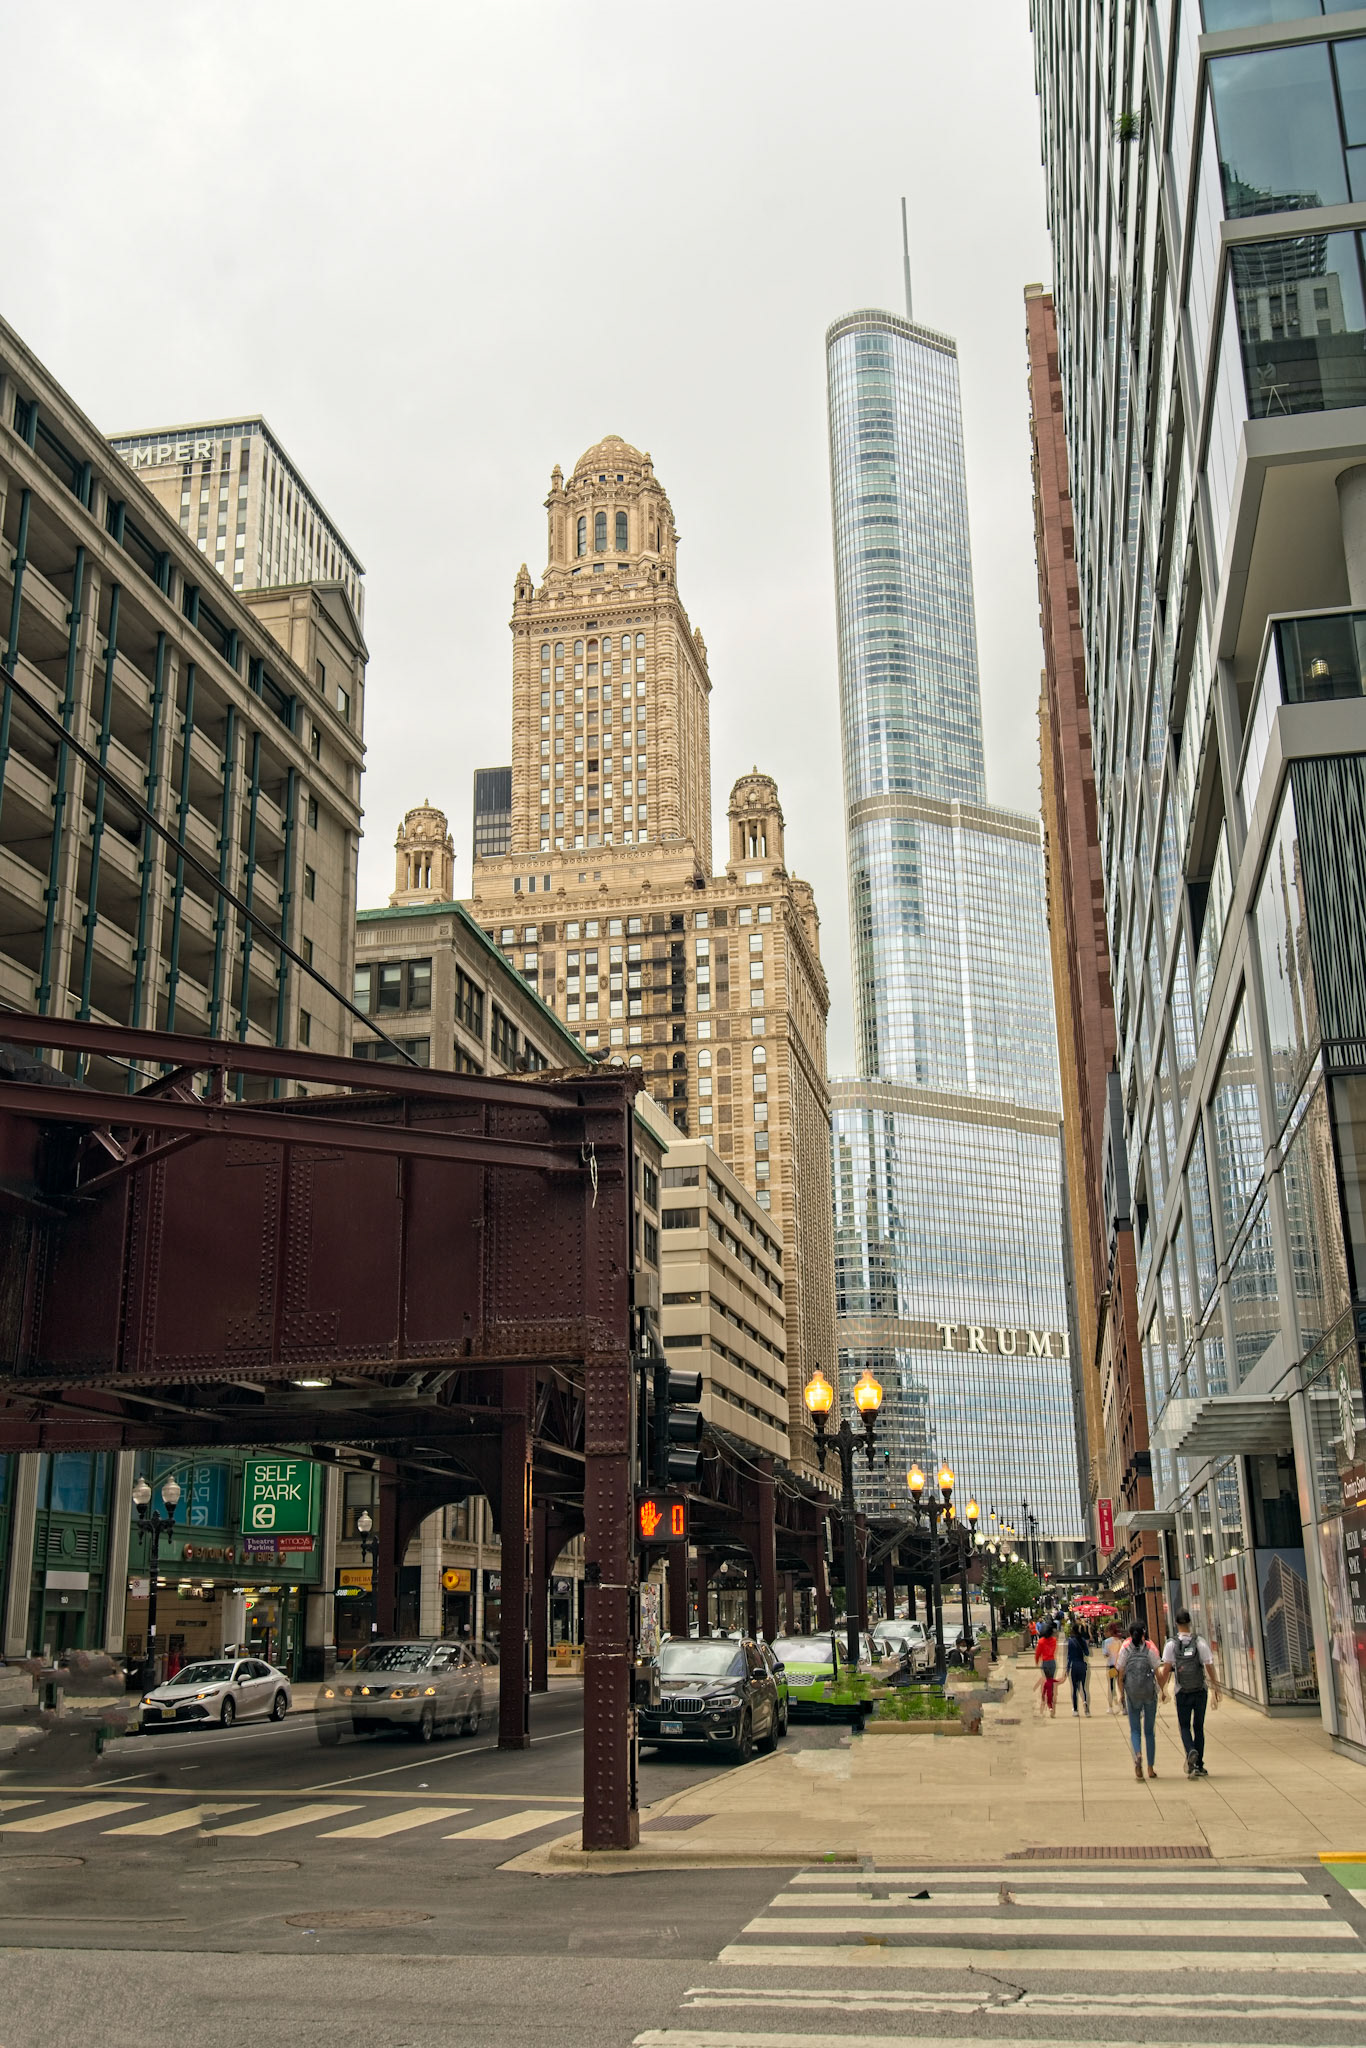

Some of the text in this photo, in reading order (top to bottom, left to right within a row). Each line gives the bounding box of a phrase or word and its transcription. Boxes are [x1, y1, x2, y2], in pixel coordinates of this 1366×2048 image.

[254, 1465, 297, 1482] SELF
[253, 1483, 302, 1501] PARK
[672, 1505, 684, 1535] 0
[247, 1544, 274, 1552] Parking
[335, 1589, 361, 1597] SUBWAY
